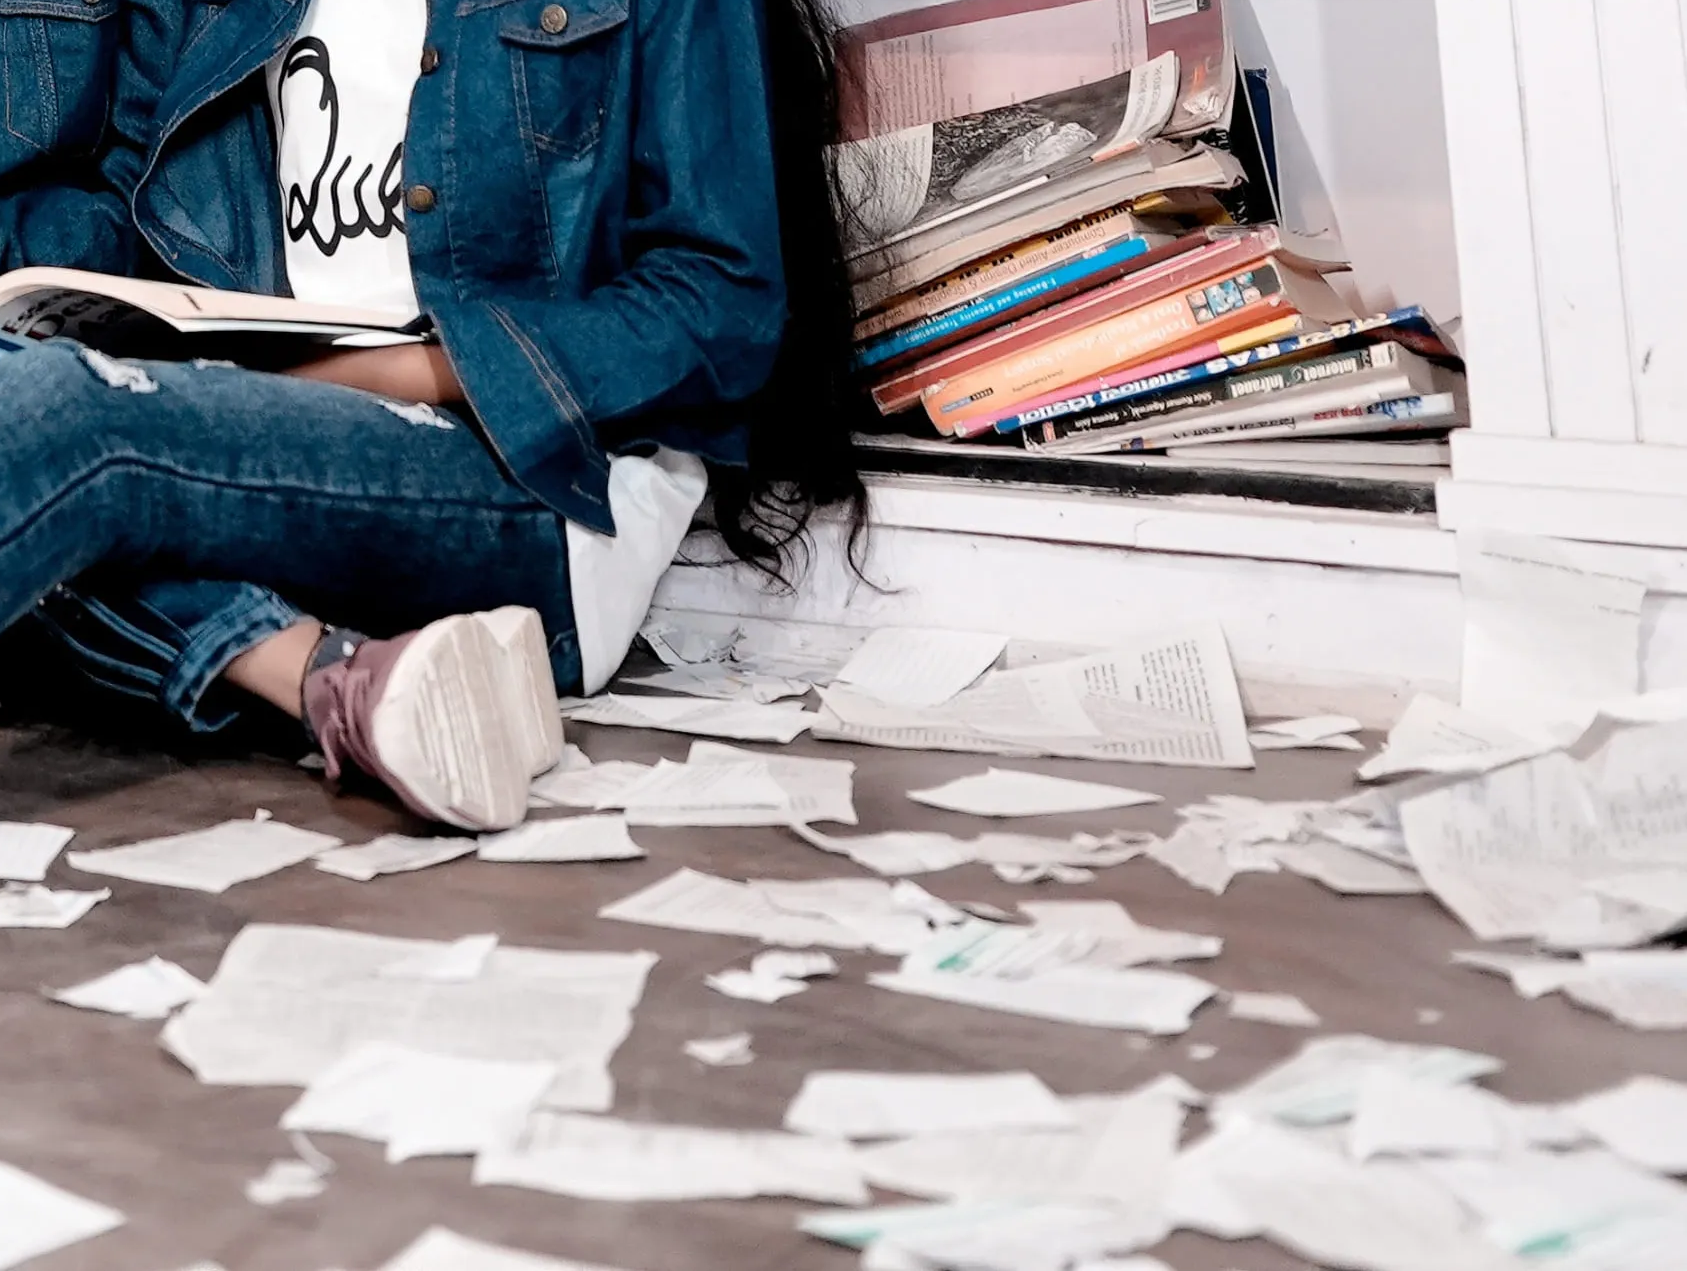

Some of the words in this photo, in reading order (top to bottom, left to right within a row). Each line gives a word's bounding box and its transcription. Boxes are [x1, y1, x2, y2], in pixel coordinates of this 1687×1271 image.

[278, 36, 407, 257] Que
[1048, 225, 1105, 256] Computer
[1017, 249, 1049, 269] Aided
[967, 279, 978, 291] &
[977, 260, 1018, 286] Design
[1012, 275, 1056, 301] E-Banking
[958, 301, 995, 324] Security
[996, 295, 1012, 308] and
[903, 317, 959, 346] Transactions
[1204, 341, 1279, 374] RAS
[1301, 357, 1356, 382] Internet
[1229, 373, 1284, 398] Intranet
